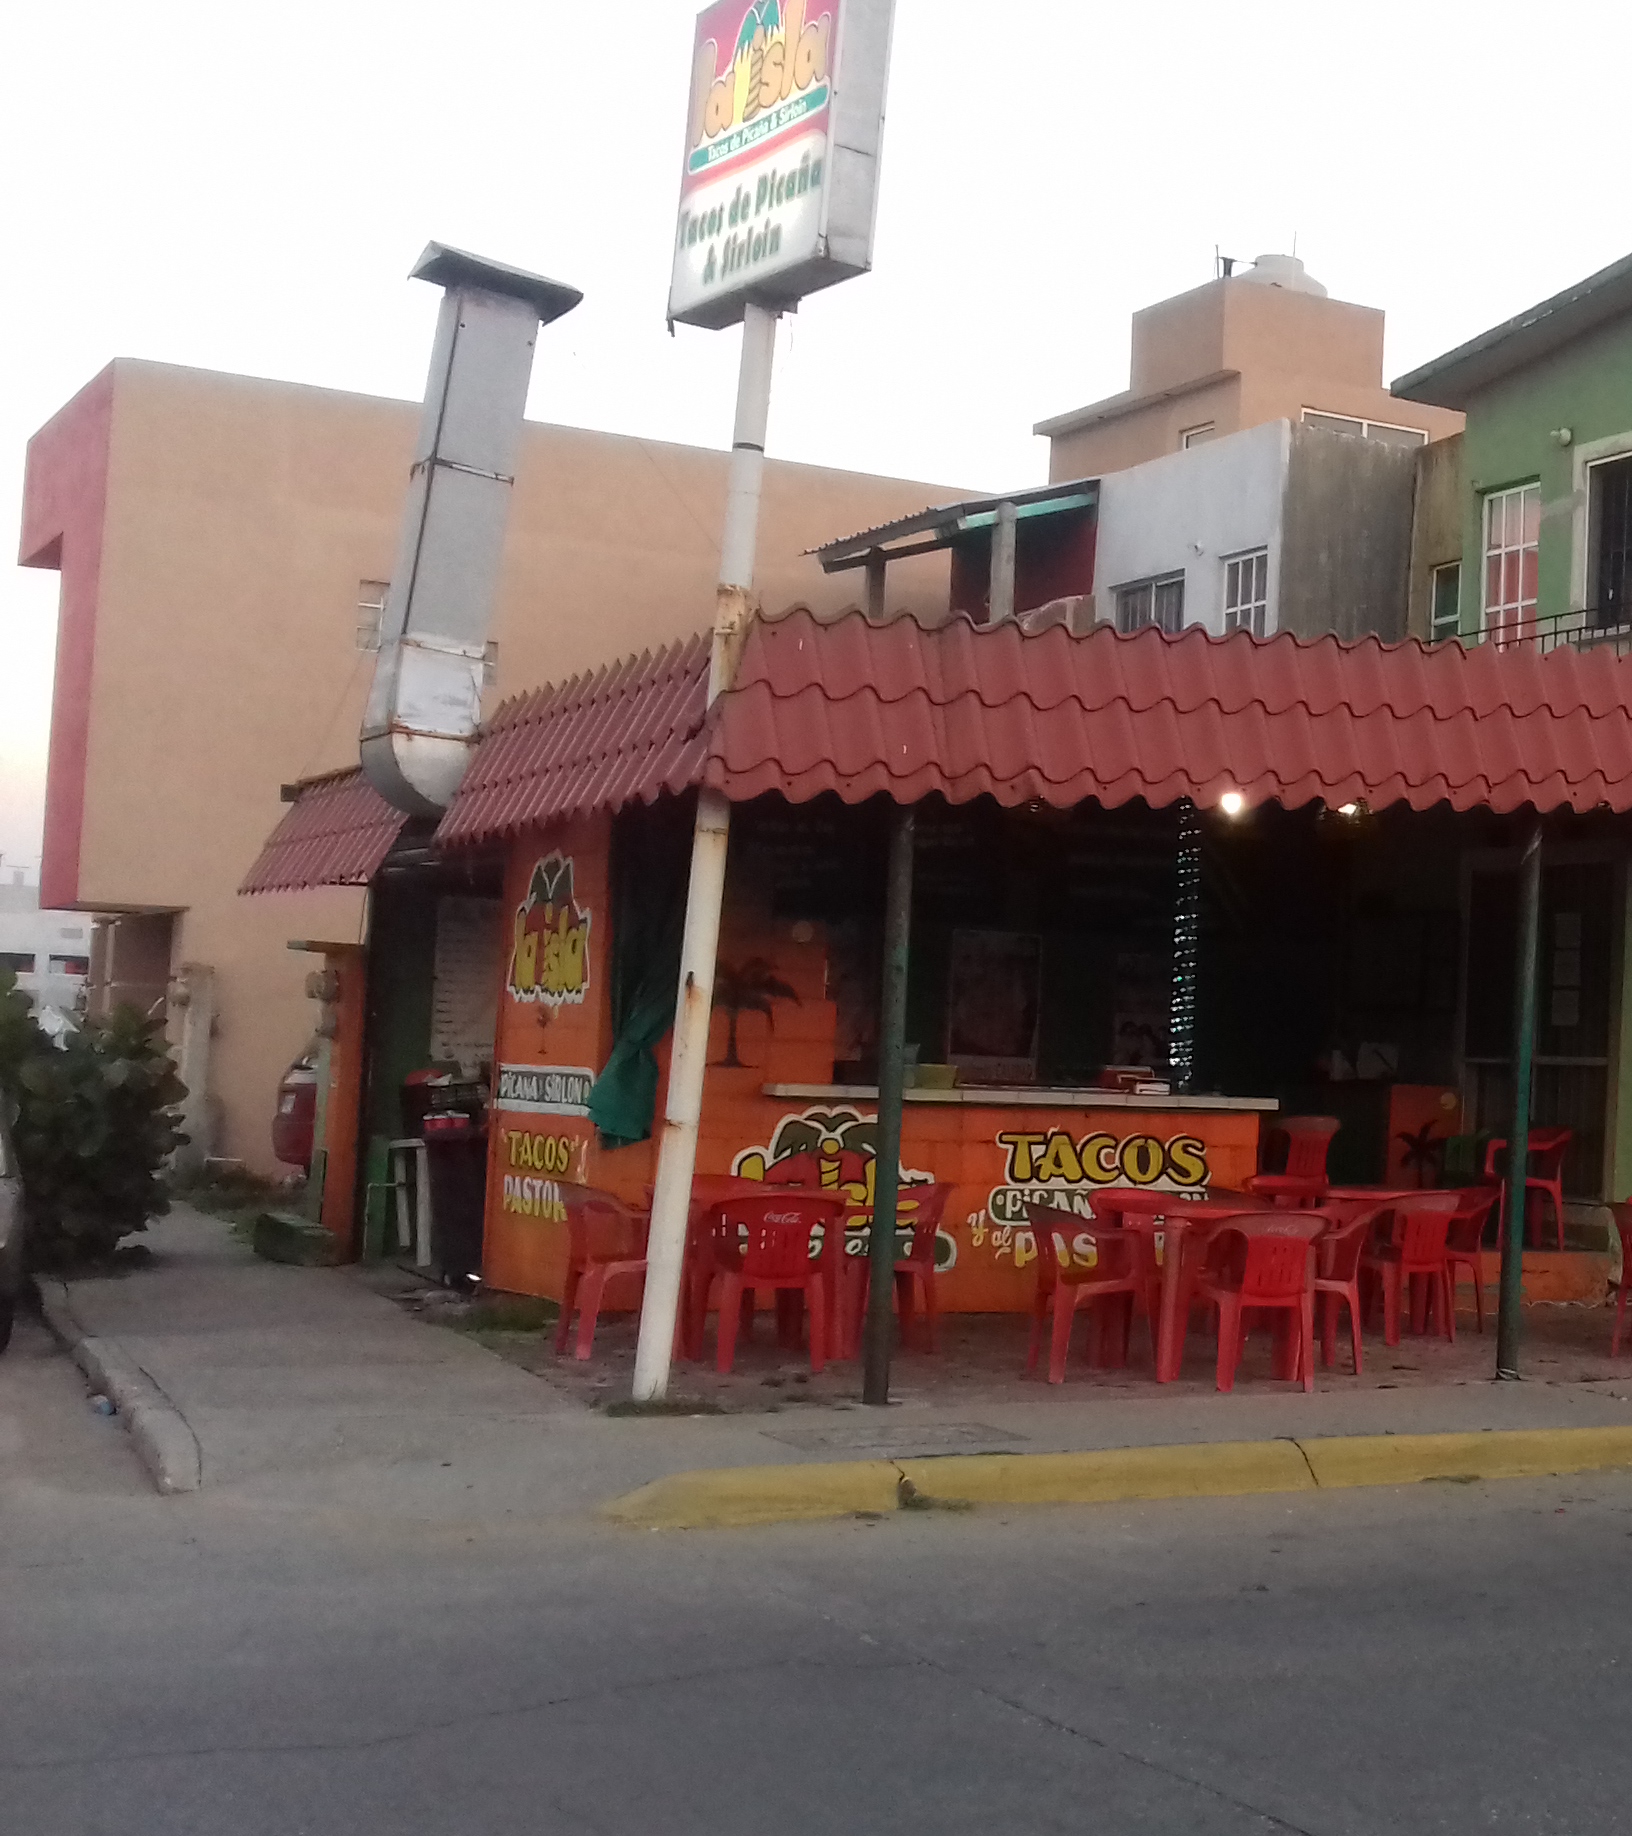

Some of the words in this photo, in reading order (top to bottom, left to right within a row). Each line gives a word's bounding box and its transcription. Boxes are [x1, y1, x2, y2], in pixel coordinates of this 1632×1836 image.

[728, 183, 751, 229] de
[755, 149, 822, 217] Picaña
[998, 1130, 1209, 1187] TACOS
